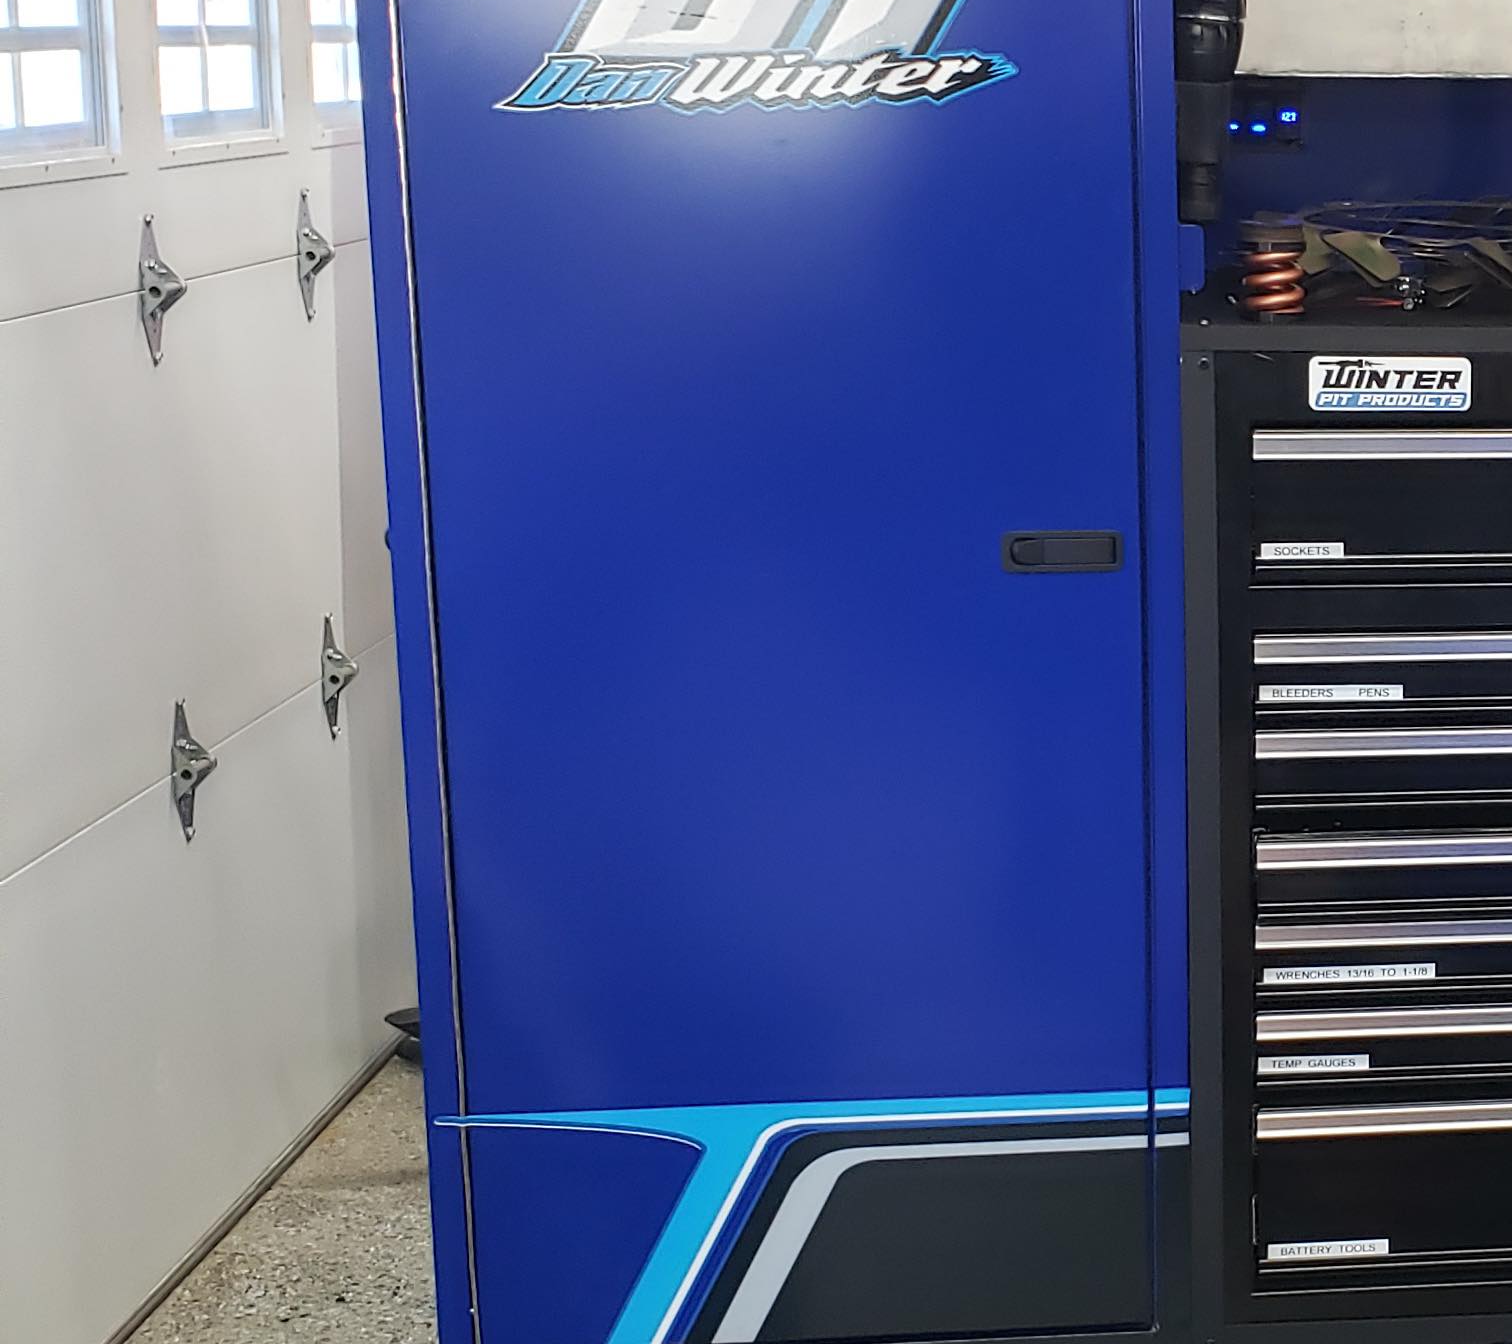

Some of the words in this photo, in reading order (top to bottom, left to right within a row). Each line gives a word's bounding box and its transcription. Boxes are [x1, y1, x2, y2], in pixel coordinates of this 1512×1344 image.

[512, 57, 672, 107] Dan
[671, 54, 983, 106] Winter
[1321, 362, 1463, 389] WINTER
[1318, 393, 1352, 406] PIT
[1357, 393, 1465, 407] PRODUCTS
[1274, 546, 1330, 556] SOCKETS
[1272, 688, 1334, 697] BLEEDERS
[1359, 687, 1390, 697] PENS
[1275, 969, 1340, 980] WRENCHES
[1347, 969, 1374, 978] 13/16
[1381, 968, 1396, 977] TO
[1403, 967, 1428, 976] 1-1/8
[1272, 1059, 1302, 1068] TEMP
[1307, 1058, 1356, 1067] GAUGES
[1280, 1245, 1332, 1256] BATTERY
[1339, 1243, 1376, 1253] TOOLS
